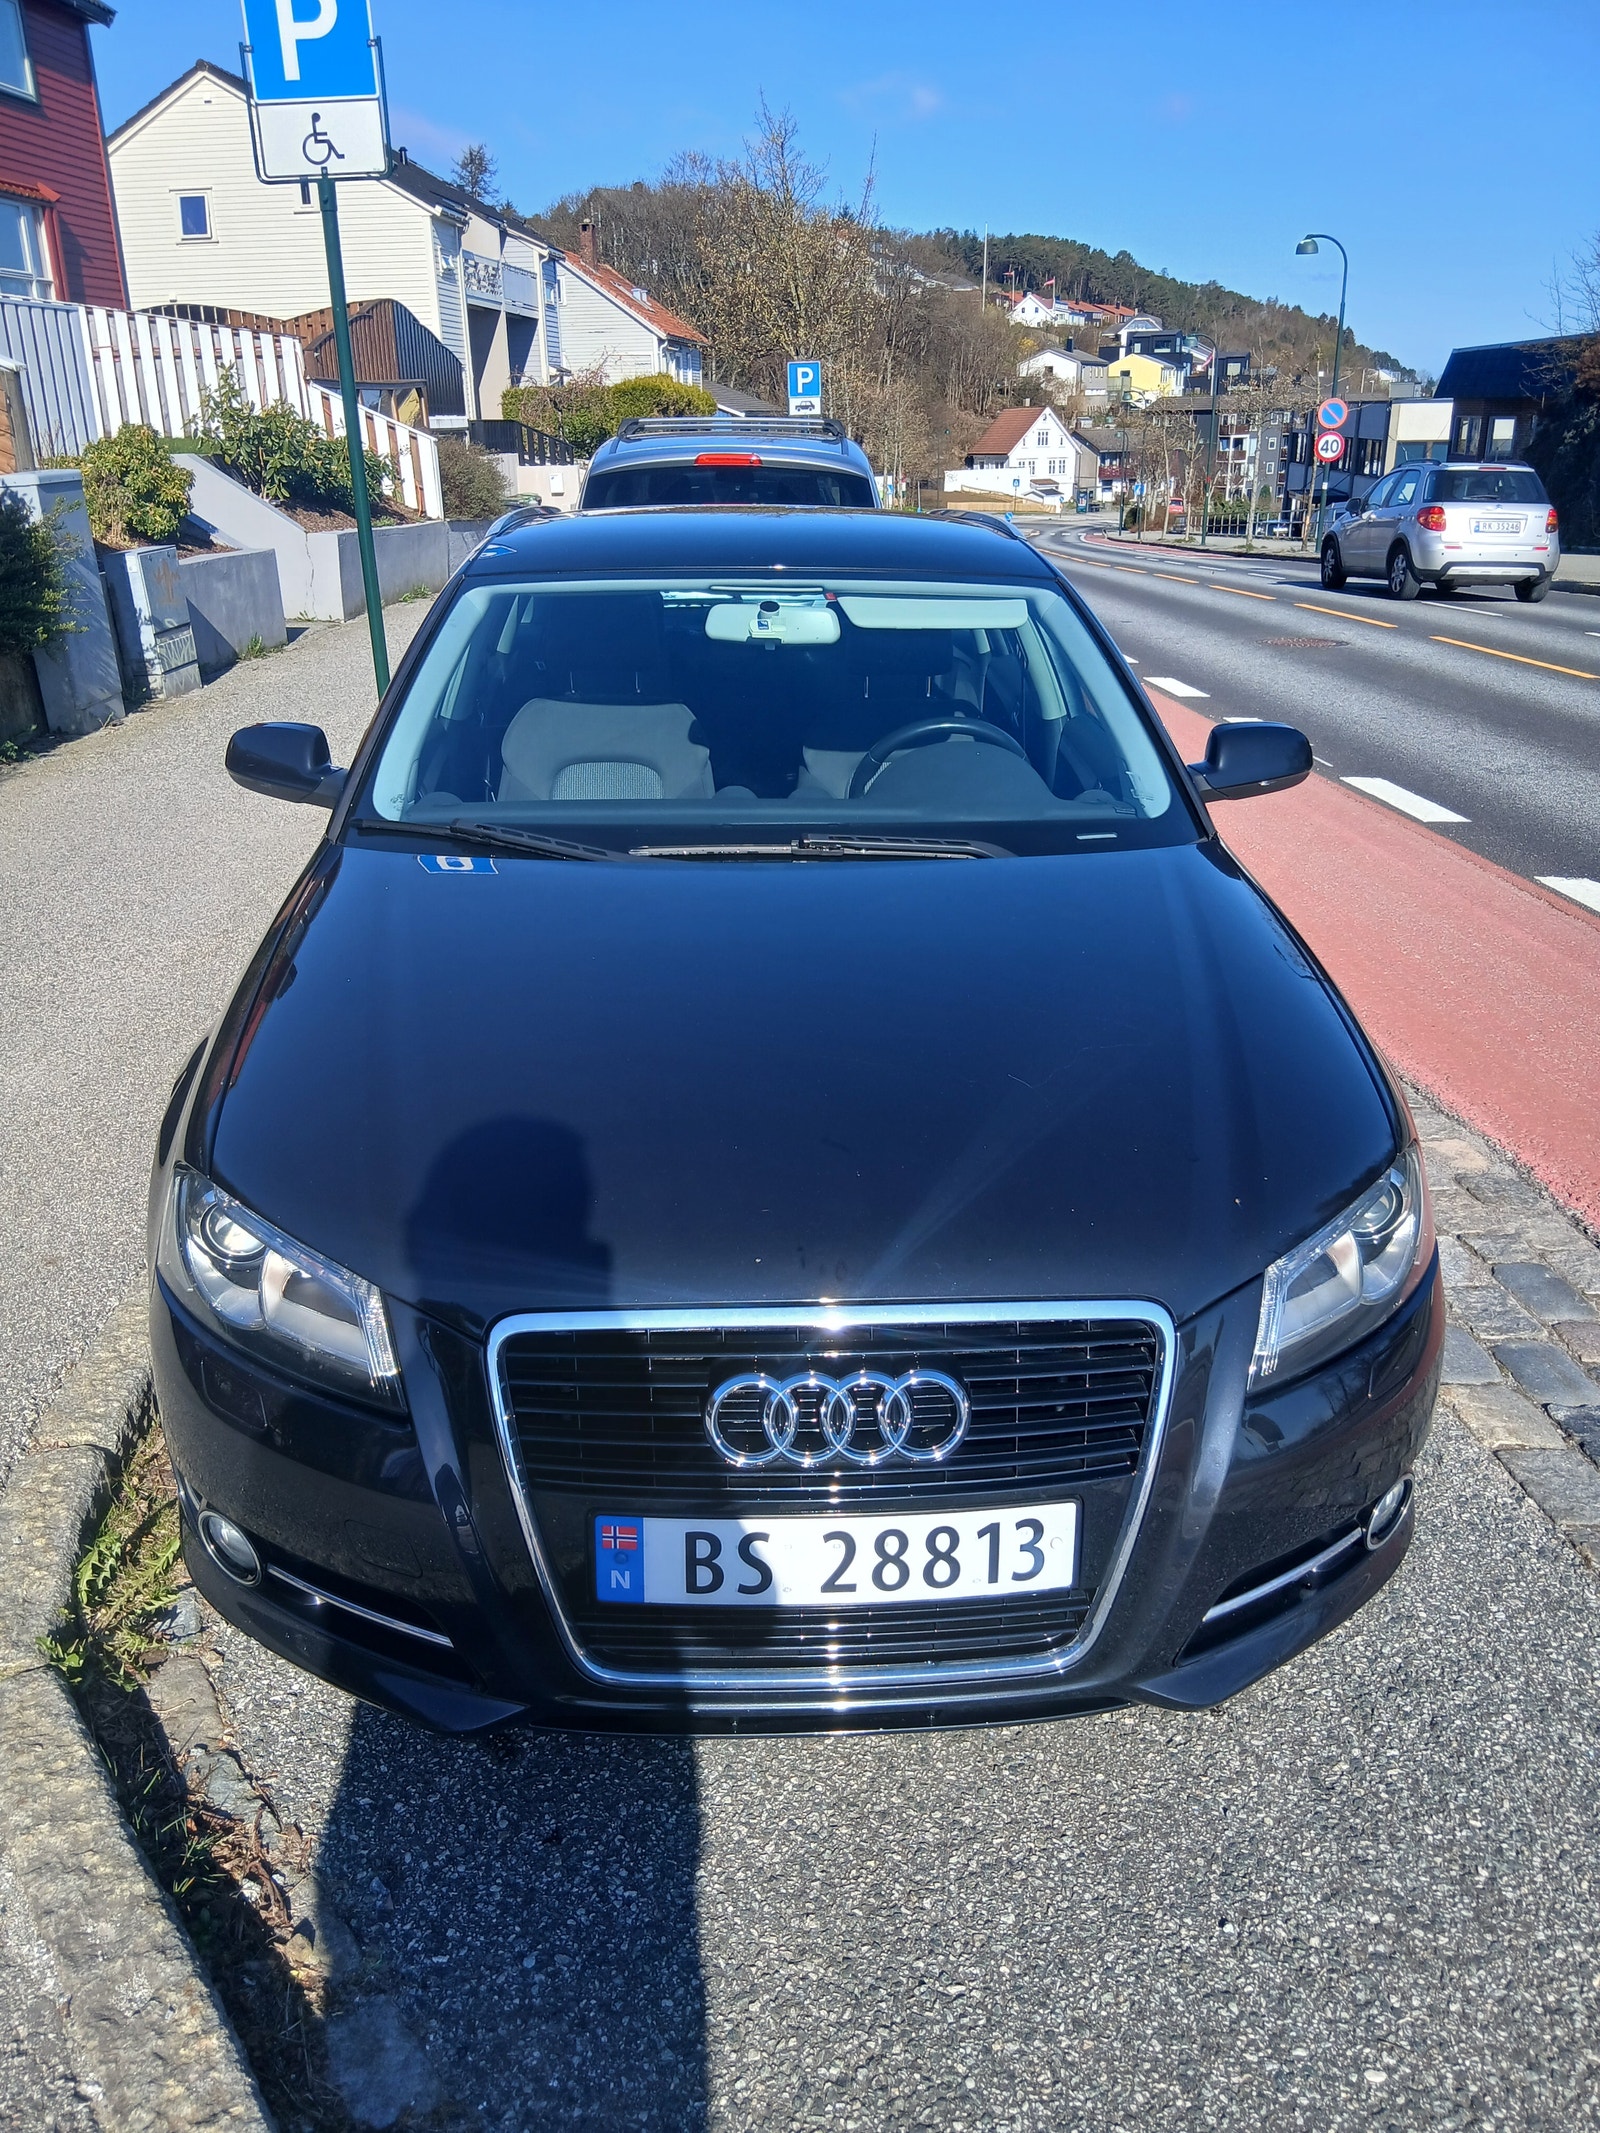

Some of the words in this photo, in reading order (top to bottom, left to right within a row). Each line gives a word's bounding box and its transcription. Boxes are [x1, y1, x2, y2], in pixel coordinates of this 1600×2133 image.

[275, 0, 338, 81] P
[797, 366, 814, 394] P
[1320, 439, 1339, 453] 40
[684, 1530, 774, 1595] BS
[820, 1517, 1046, 1594] 28813
[610, 1569, 631, 1589] N
